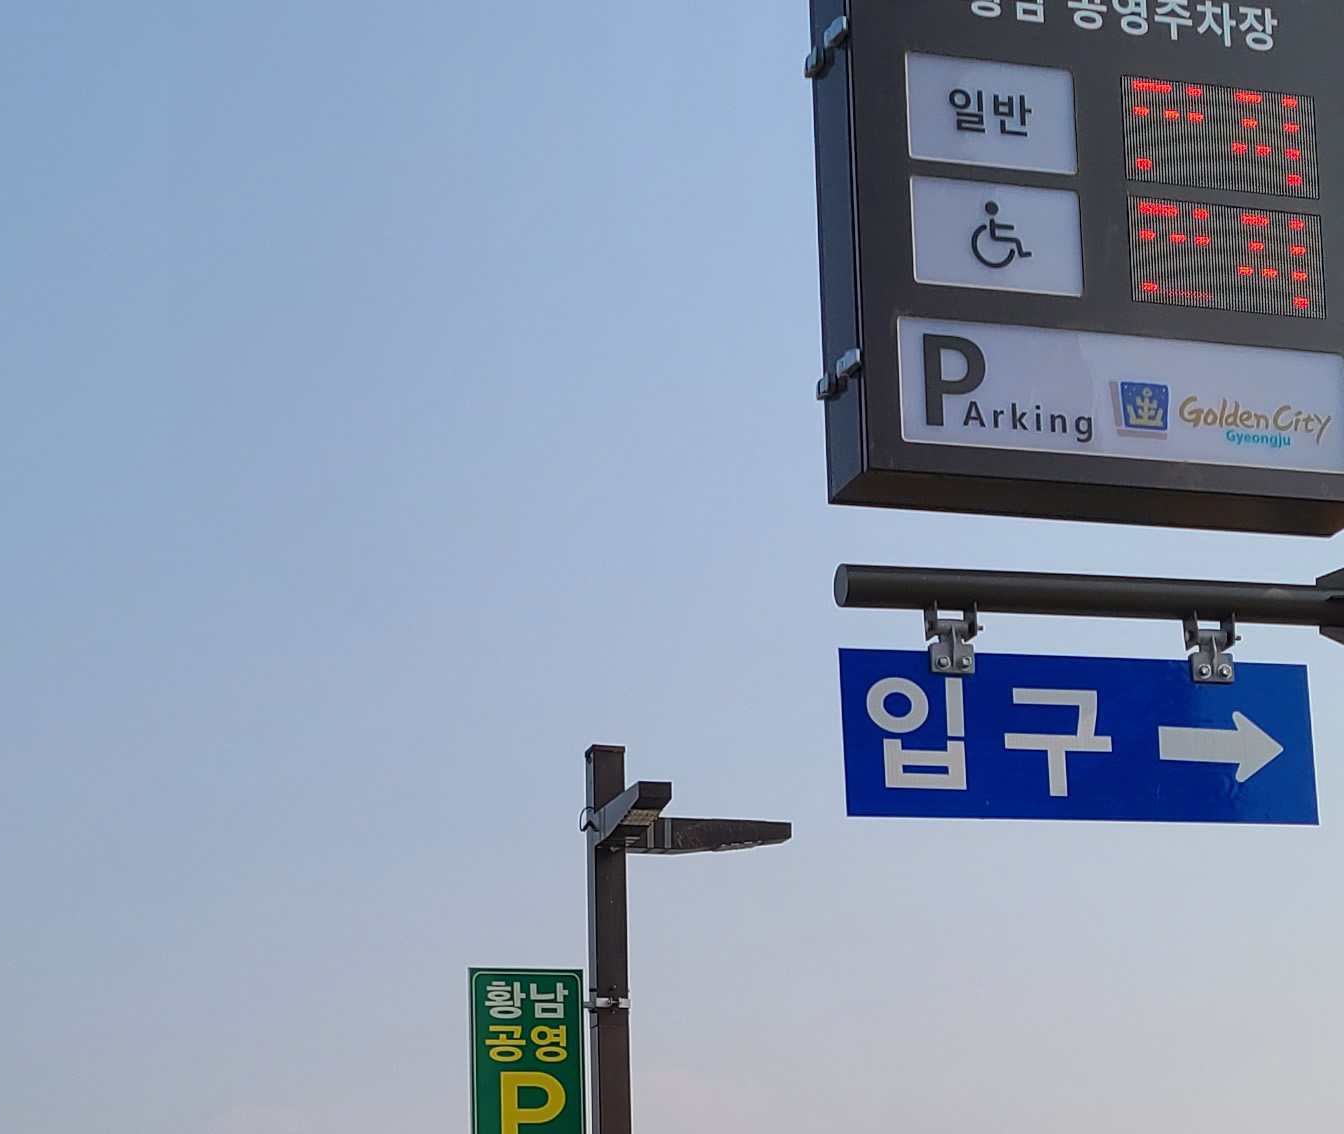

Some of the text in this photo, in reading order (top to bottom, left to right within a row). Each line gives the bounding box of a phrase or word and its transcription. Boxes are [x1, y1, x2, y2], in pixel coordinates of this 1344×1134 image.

[1067, 0, 1278, 51] 공영주차장
[948, 88, 1033, 138] 일반
[1178, 396, 1267, 430] Golden
[1225, 429, 1292, 449] Gyeongju
[866, 676, 1113, 797] 입구
[484, 980, 569, 1020] 황남
[484, 1024, 568, 1063] 공영
